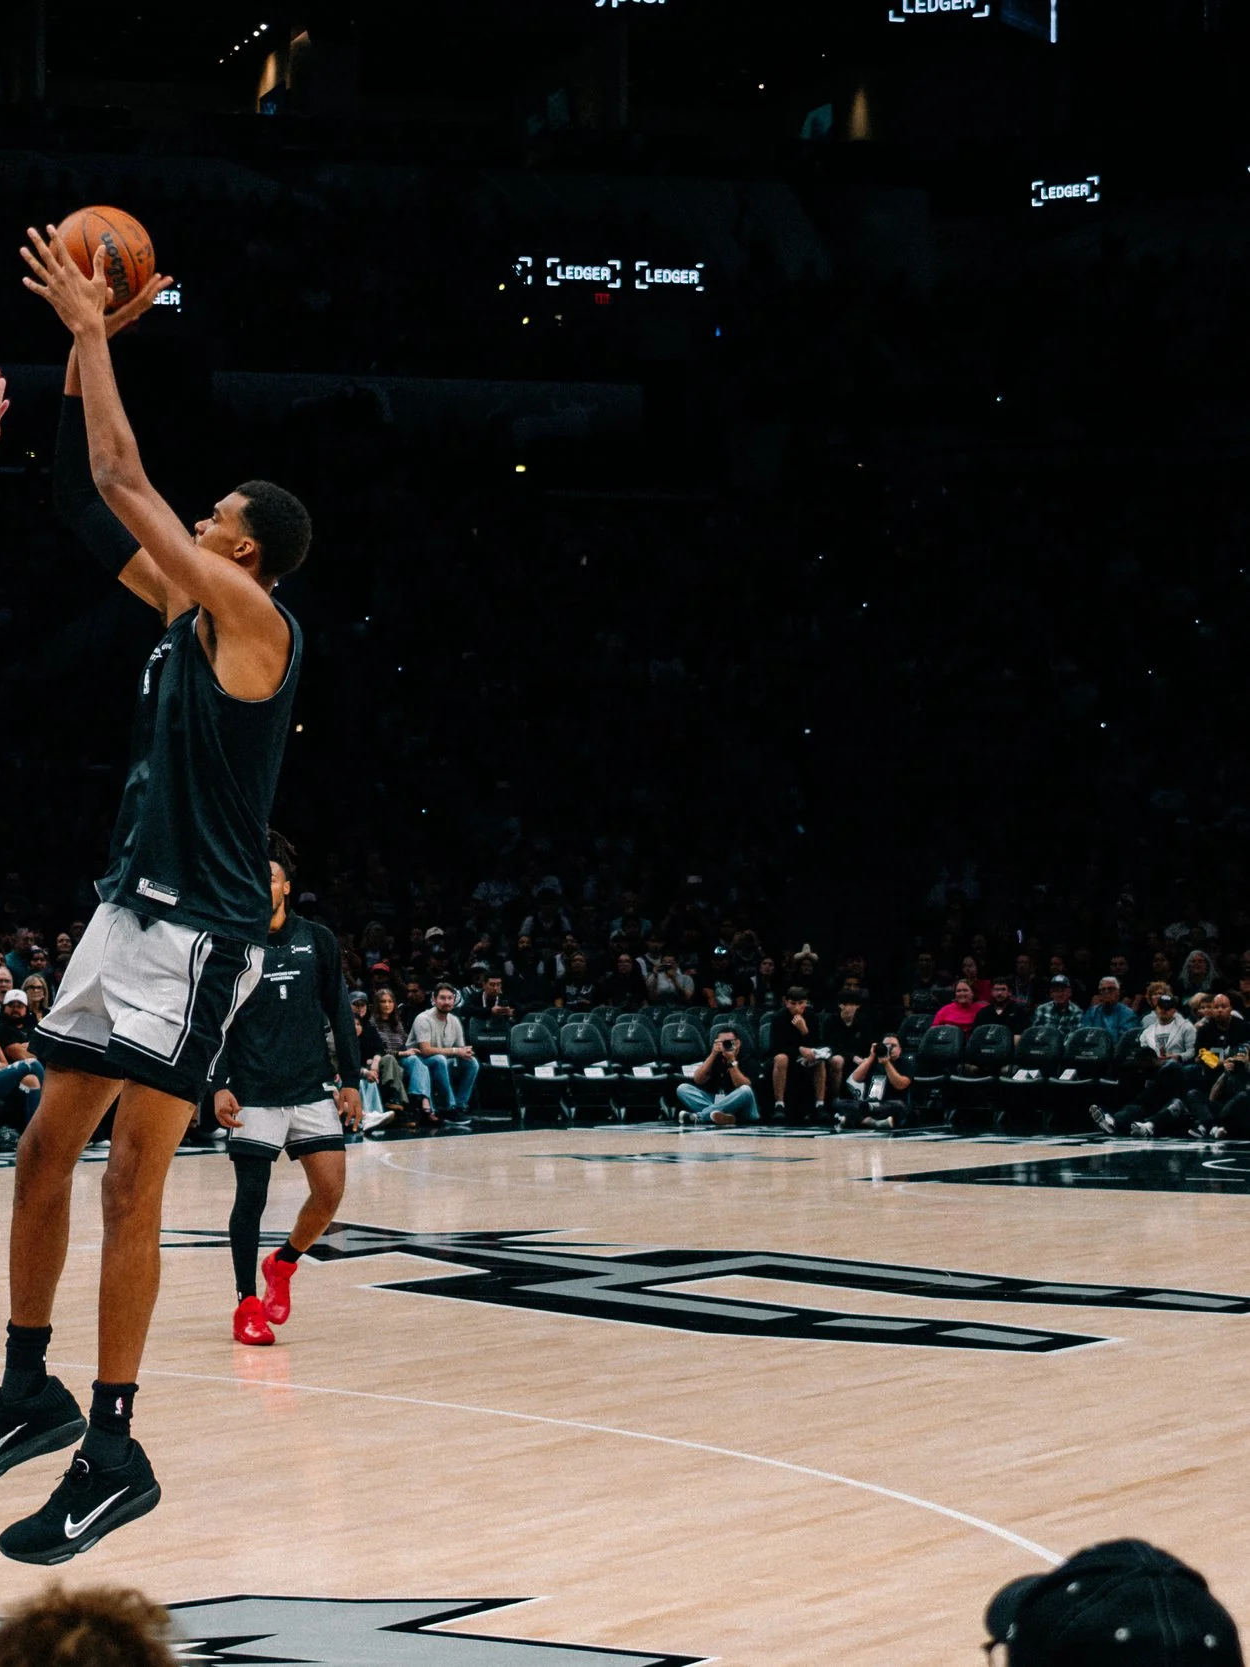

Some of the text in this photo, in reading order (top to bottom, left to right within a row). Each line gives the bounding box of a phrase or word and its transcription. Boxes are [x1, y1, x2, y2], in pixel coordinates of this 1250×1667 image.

[1040, 183, 1090, 200] LEDGER
[556, 265, 611, 281] LEDGER
[645, 268, 700, 284] LEDGER
